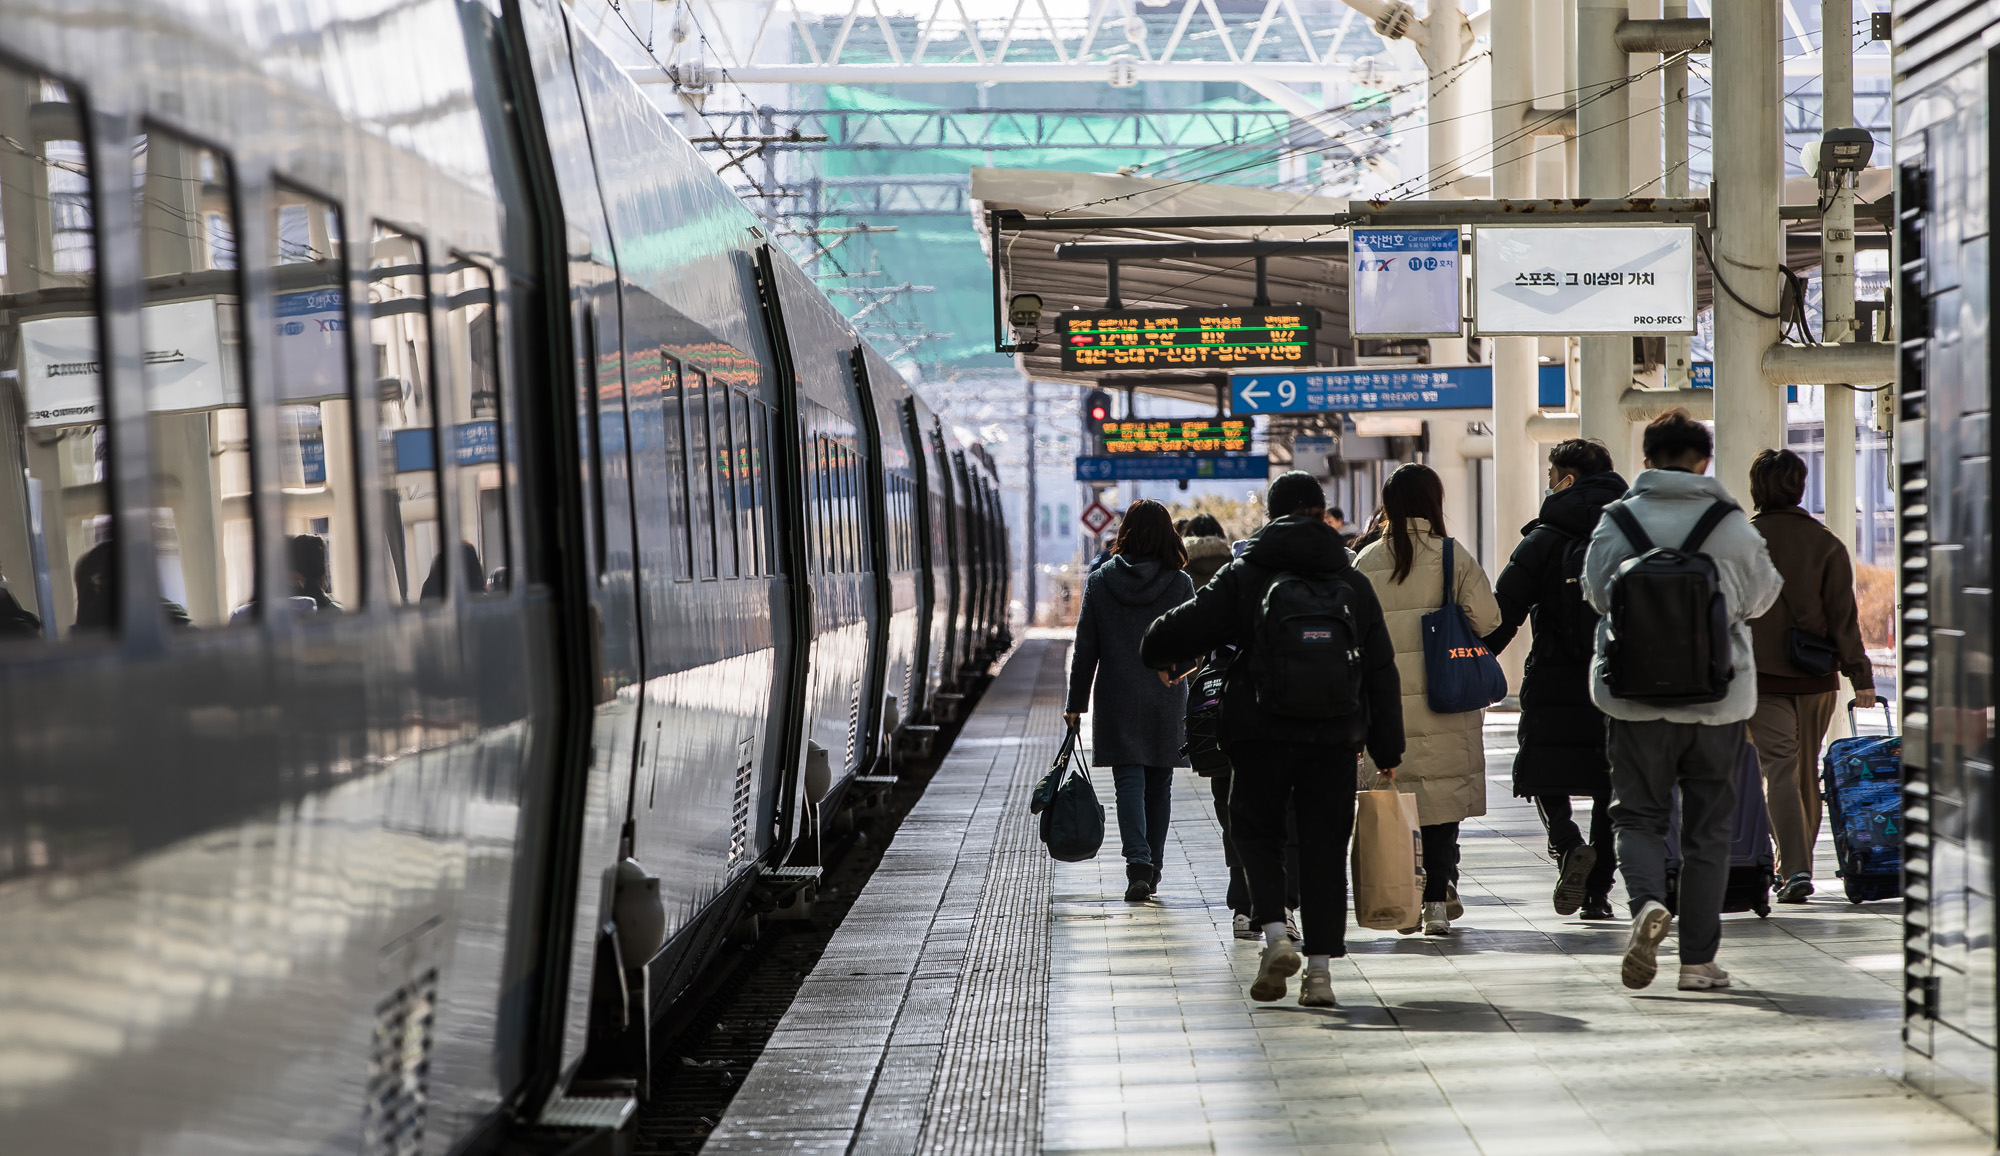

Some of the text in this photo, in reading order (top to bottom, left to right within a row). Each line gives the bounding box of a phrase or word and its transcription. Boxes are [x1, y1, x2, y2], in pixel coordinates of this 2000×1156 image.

[1357, 234, 1404, 248] 호차번호
[1358, 257, 1398, 272] KTX
[1425, 259, 1437, 270] 12
[1439, 259, 1453, 268] 호차
[1515, 272, 1655, 287] 스포츠, 그 이상의 가치
[1277, 379, 1296, 408] 9
